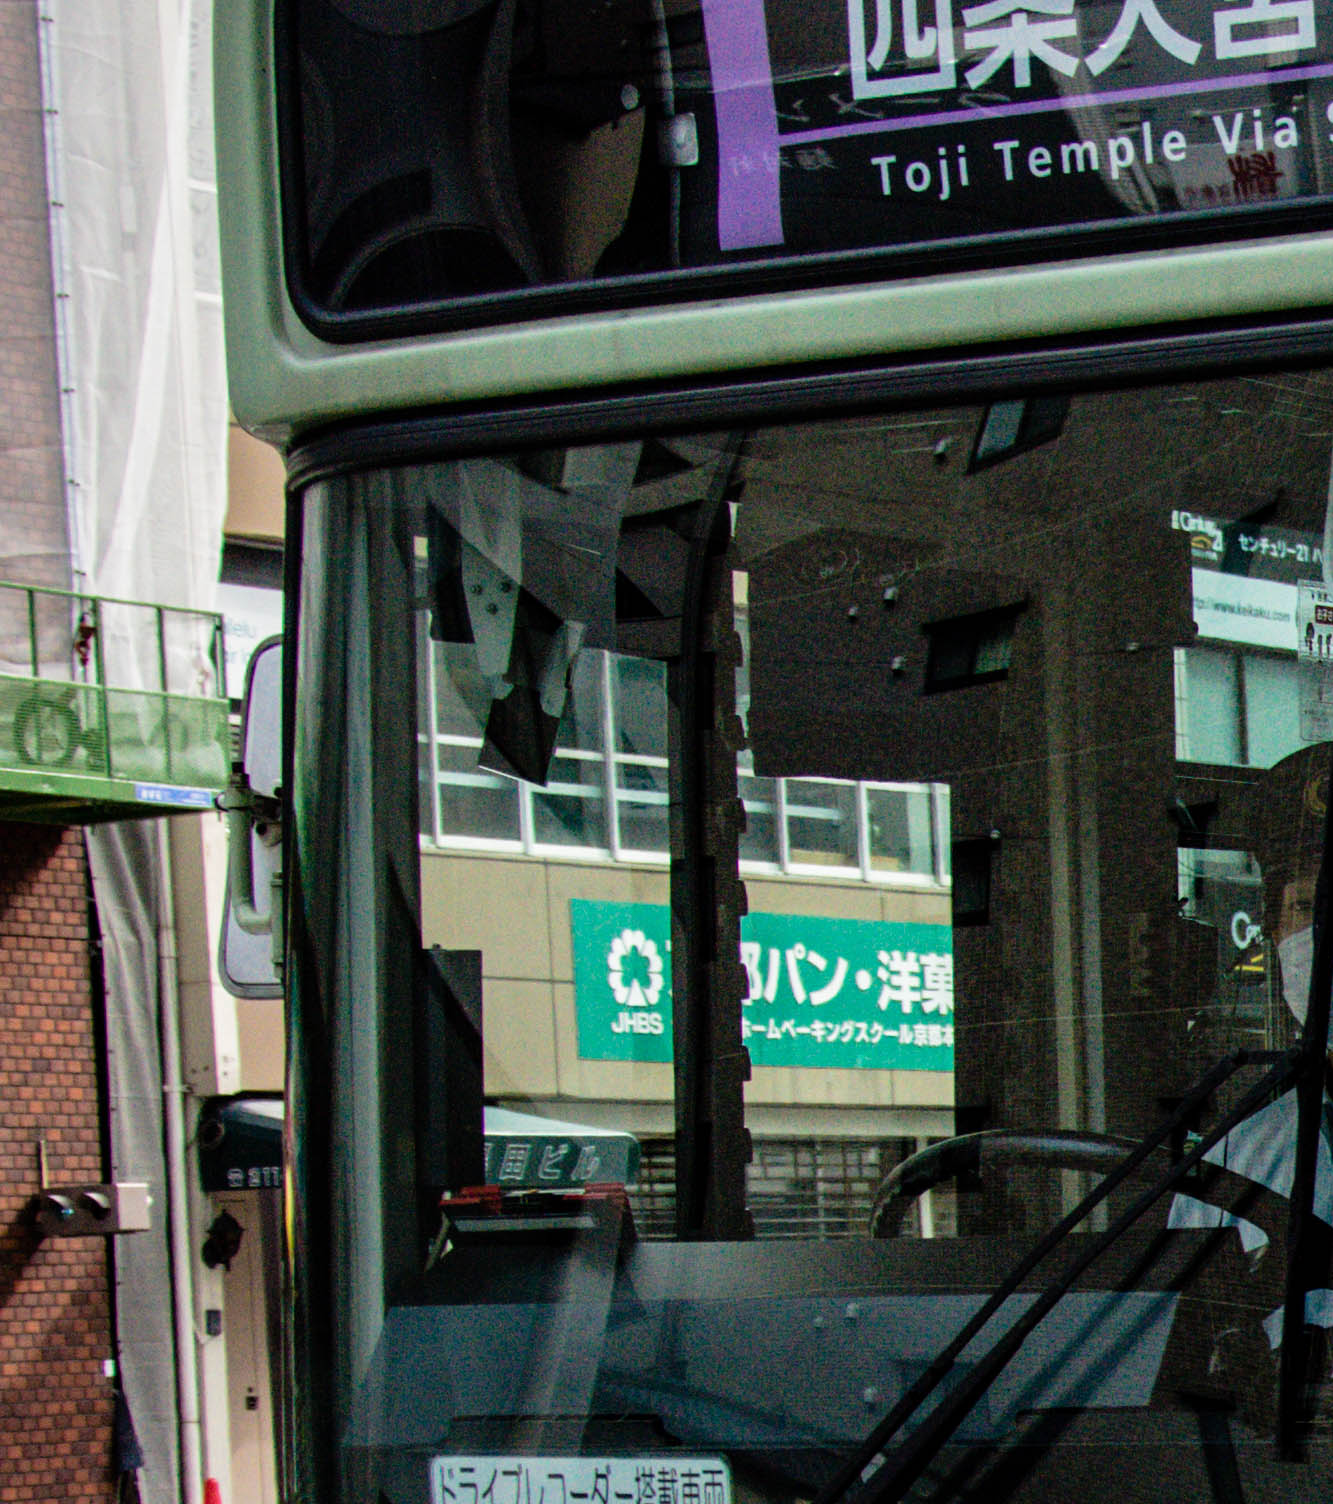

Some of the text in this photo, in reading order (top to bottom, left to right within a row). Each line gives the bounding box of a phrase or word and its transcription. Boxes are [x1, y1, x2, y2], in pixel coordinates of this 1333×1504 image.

[872, 153, 973, 200] Toji
[1001, 129, 1187, 182] Temple
[1217, 106, 1299, 156] Via
[611, 1011, 665, 1035] JHBS
